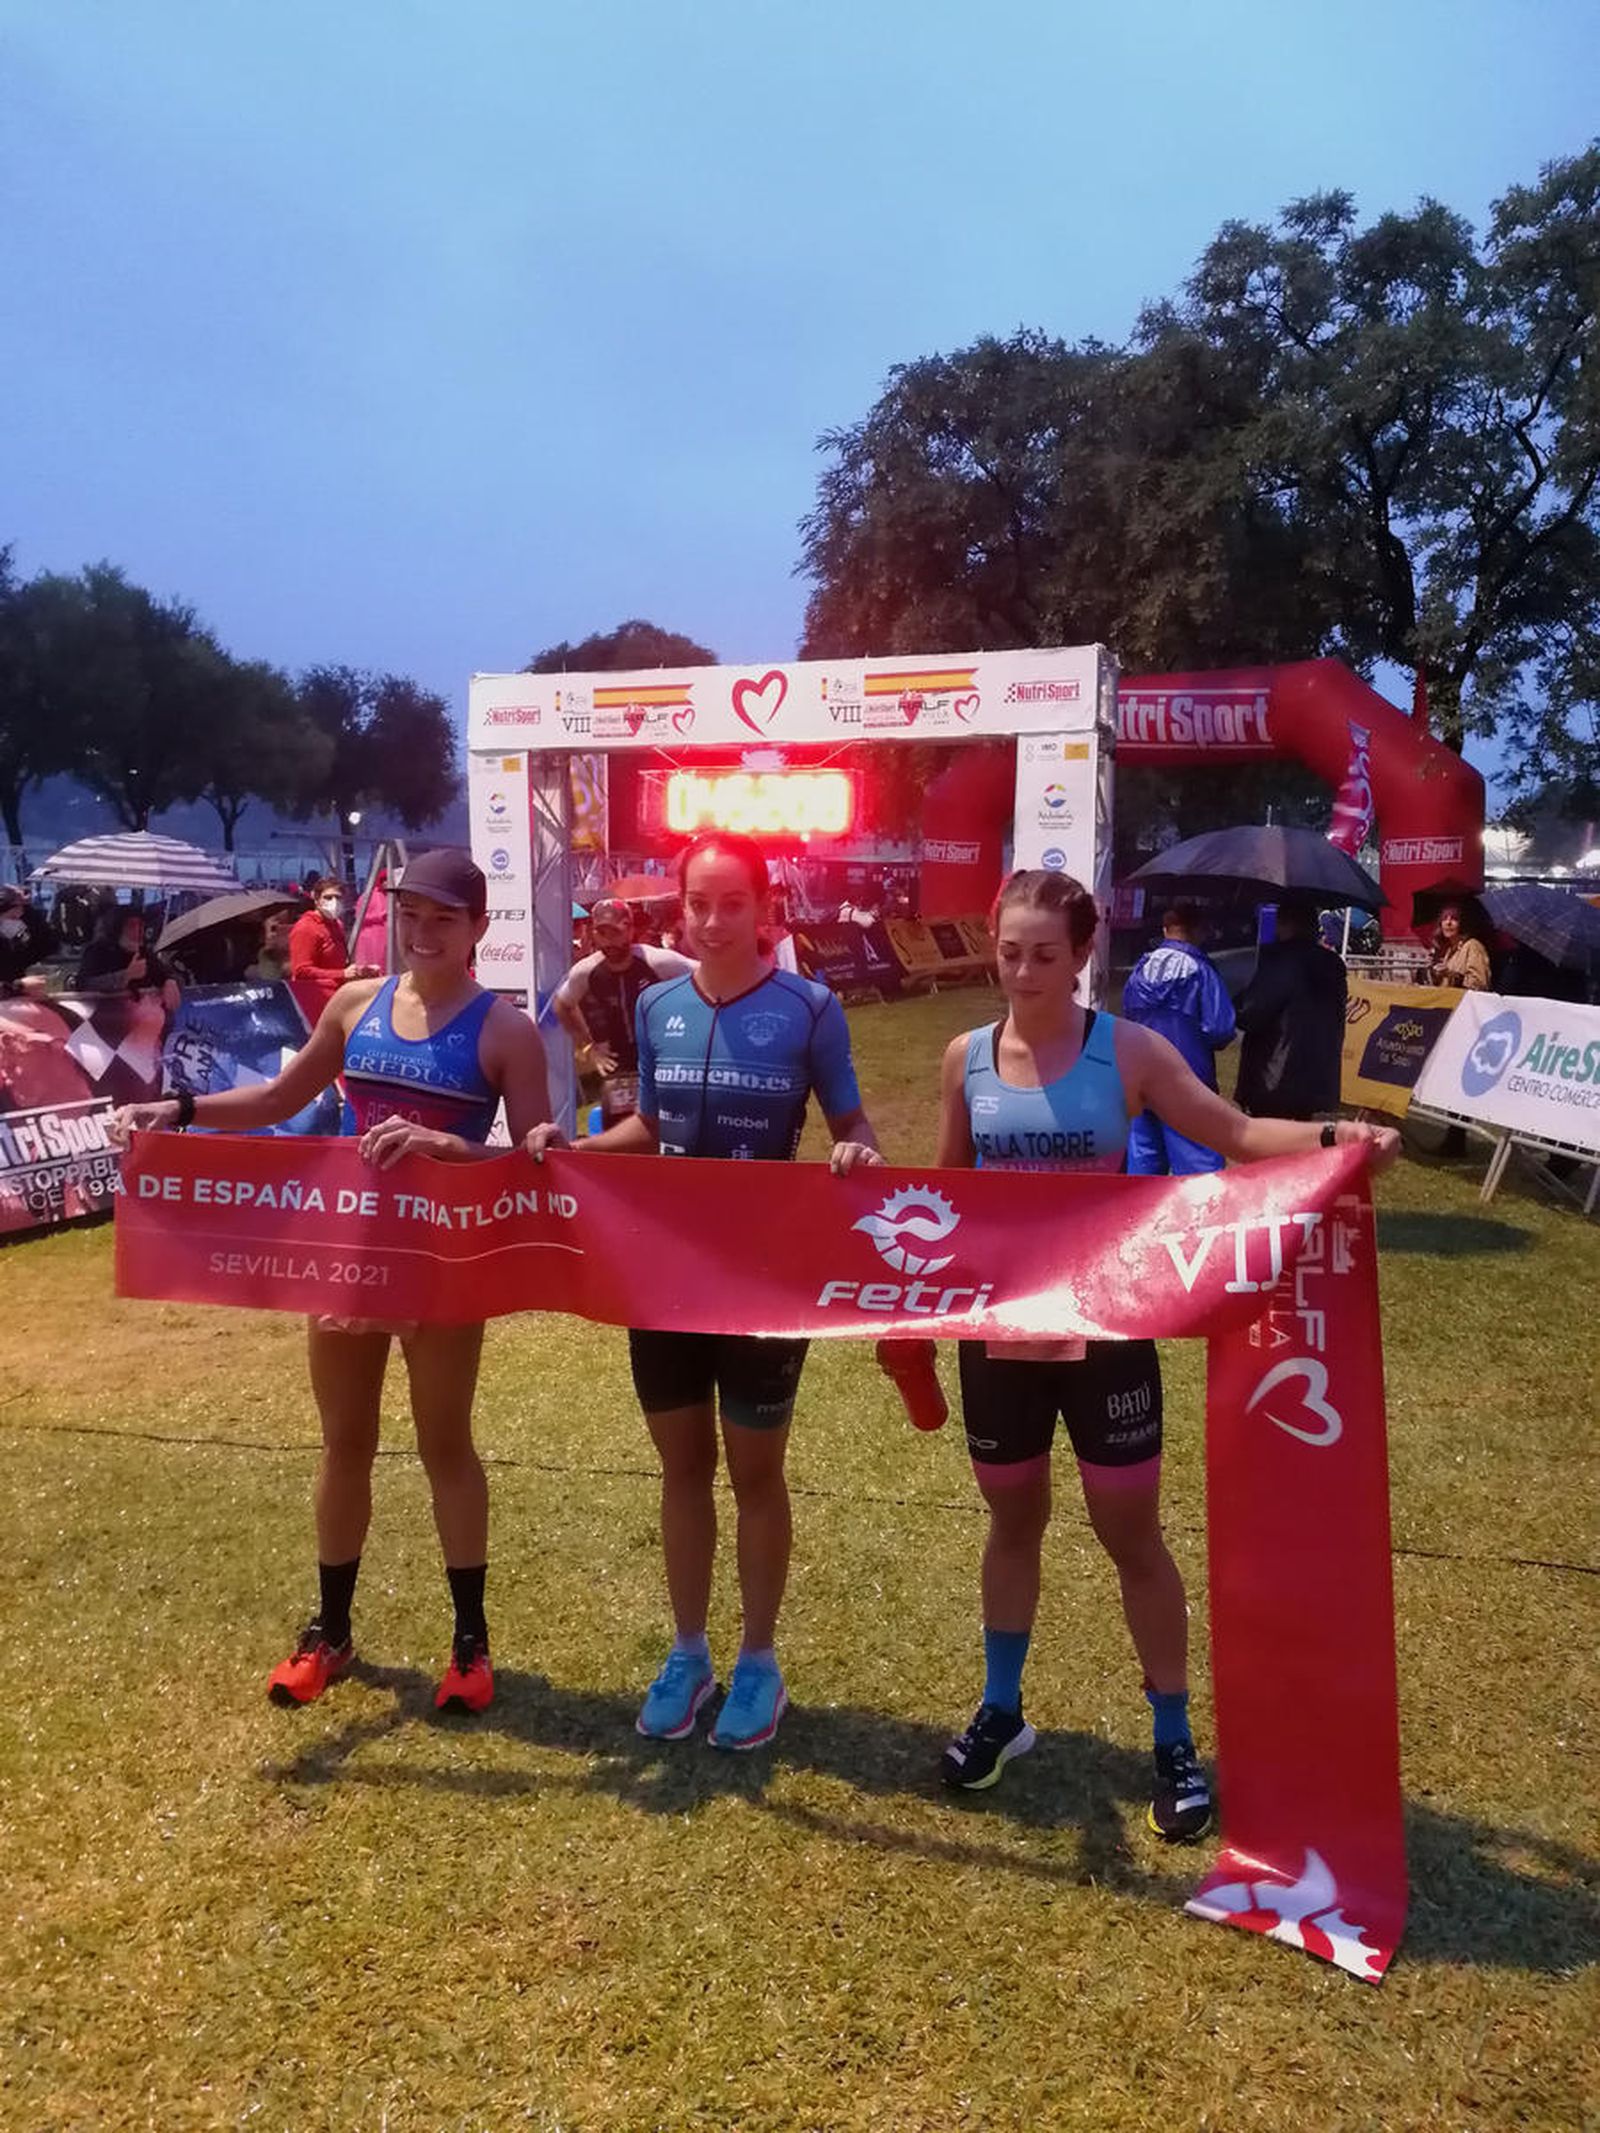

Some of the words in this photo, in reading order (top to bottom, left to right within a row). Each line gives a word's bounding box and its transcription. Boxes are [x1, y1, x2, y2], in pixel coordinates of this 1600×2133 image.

[1016, 682, 1080, 701] NutriSport
[563, 717, 591, 733] VIII
[829, 706, 862, 723] VIII
[1387, 841, 1462, 862] NutriSport
[346, 1053, 463, 1090] CREDUS
[1508, 1075, 1550, 1098] CENTRO
[717, 1114, 769, 1130] mobel
[995, 1134, 1023, 1158] LA
[1023, 1130, 1096, 1158] TORRE
[139, 1174, 182, 1201] DE
[193, 1177, 326, 1213] ESPAÑA
[336, 1190, 379, 1216] DE
[394, 1190, 538, 1230] TRIATLÓN
[209, 1252, 320, 1281] SEVILLA
[329, 1262, 390, 1287] 2021
